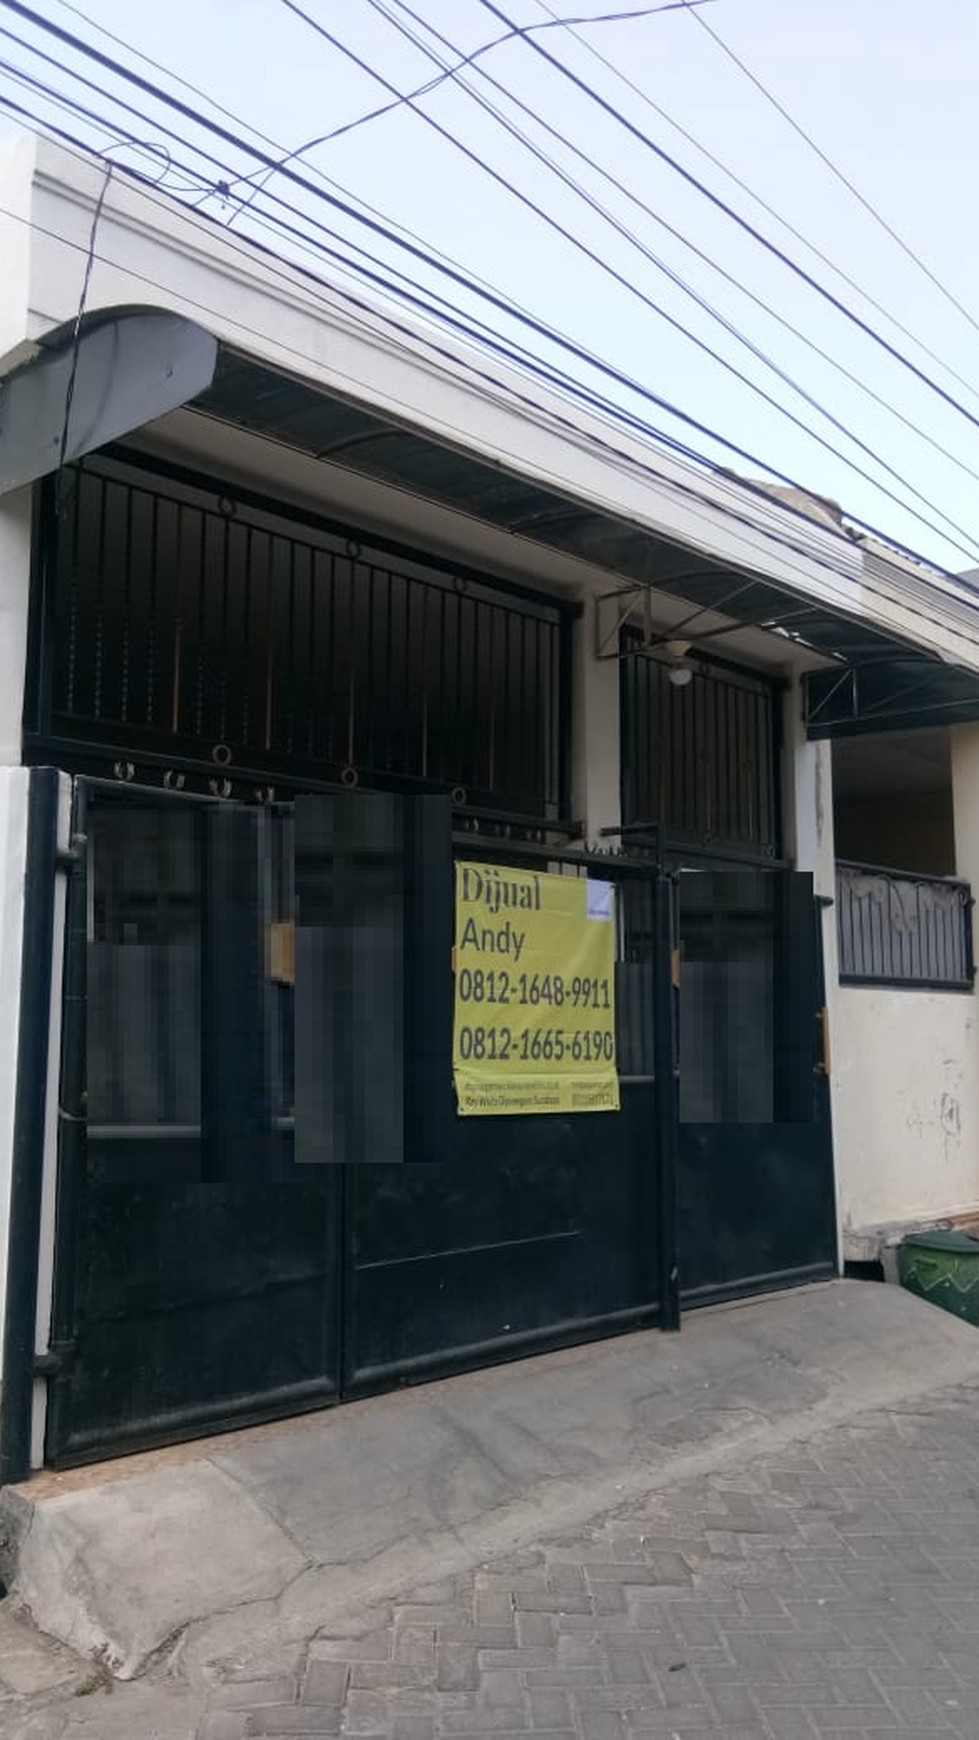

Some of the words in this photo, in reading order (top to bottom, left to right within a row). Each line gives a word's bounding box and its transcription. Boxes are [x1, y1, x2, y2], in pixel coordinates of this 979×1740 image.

[463, 868, 541, 914] Dijual
[460, 917, 525, 961] Andy
[459, 968, 611, 1008] 0812-1648-9911
[459, 1026, 613, 1061] 0812-1665-6190
